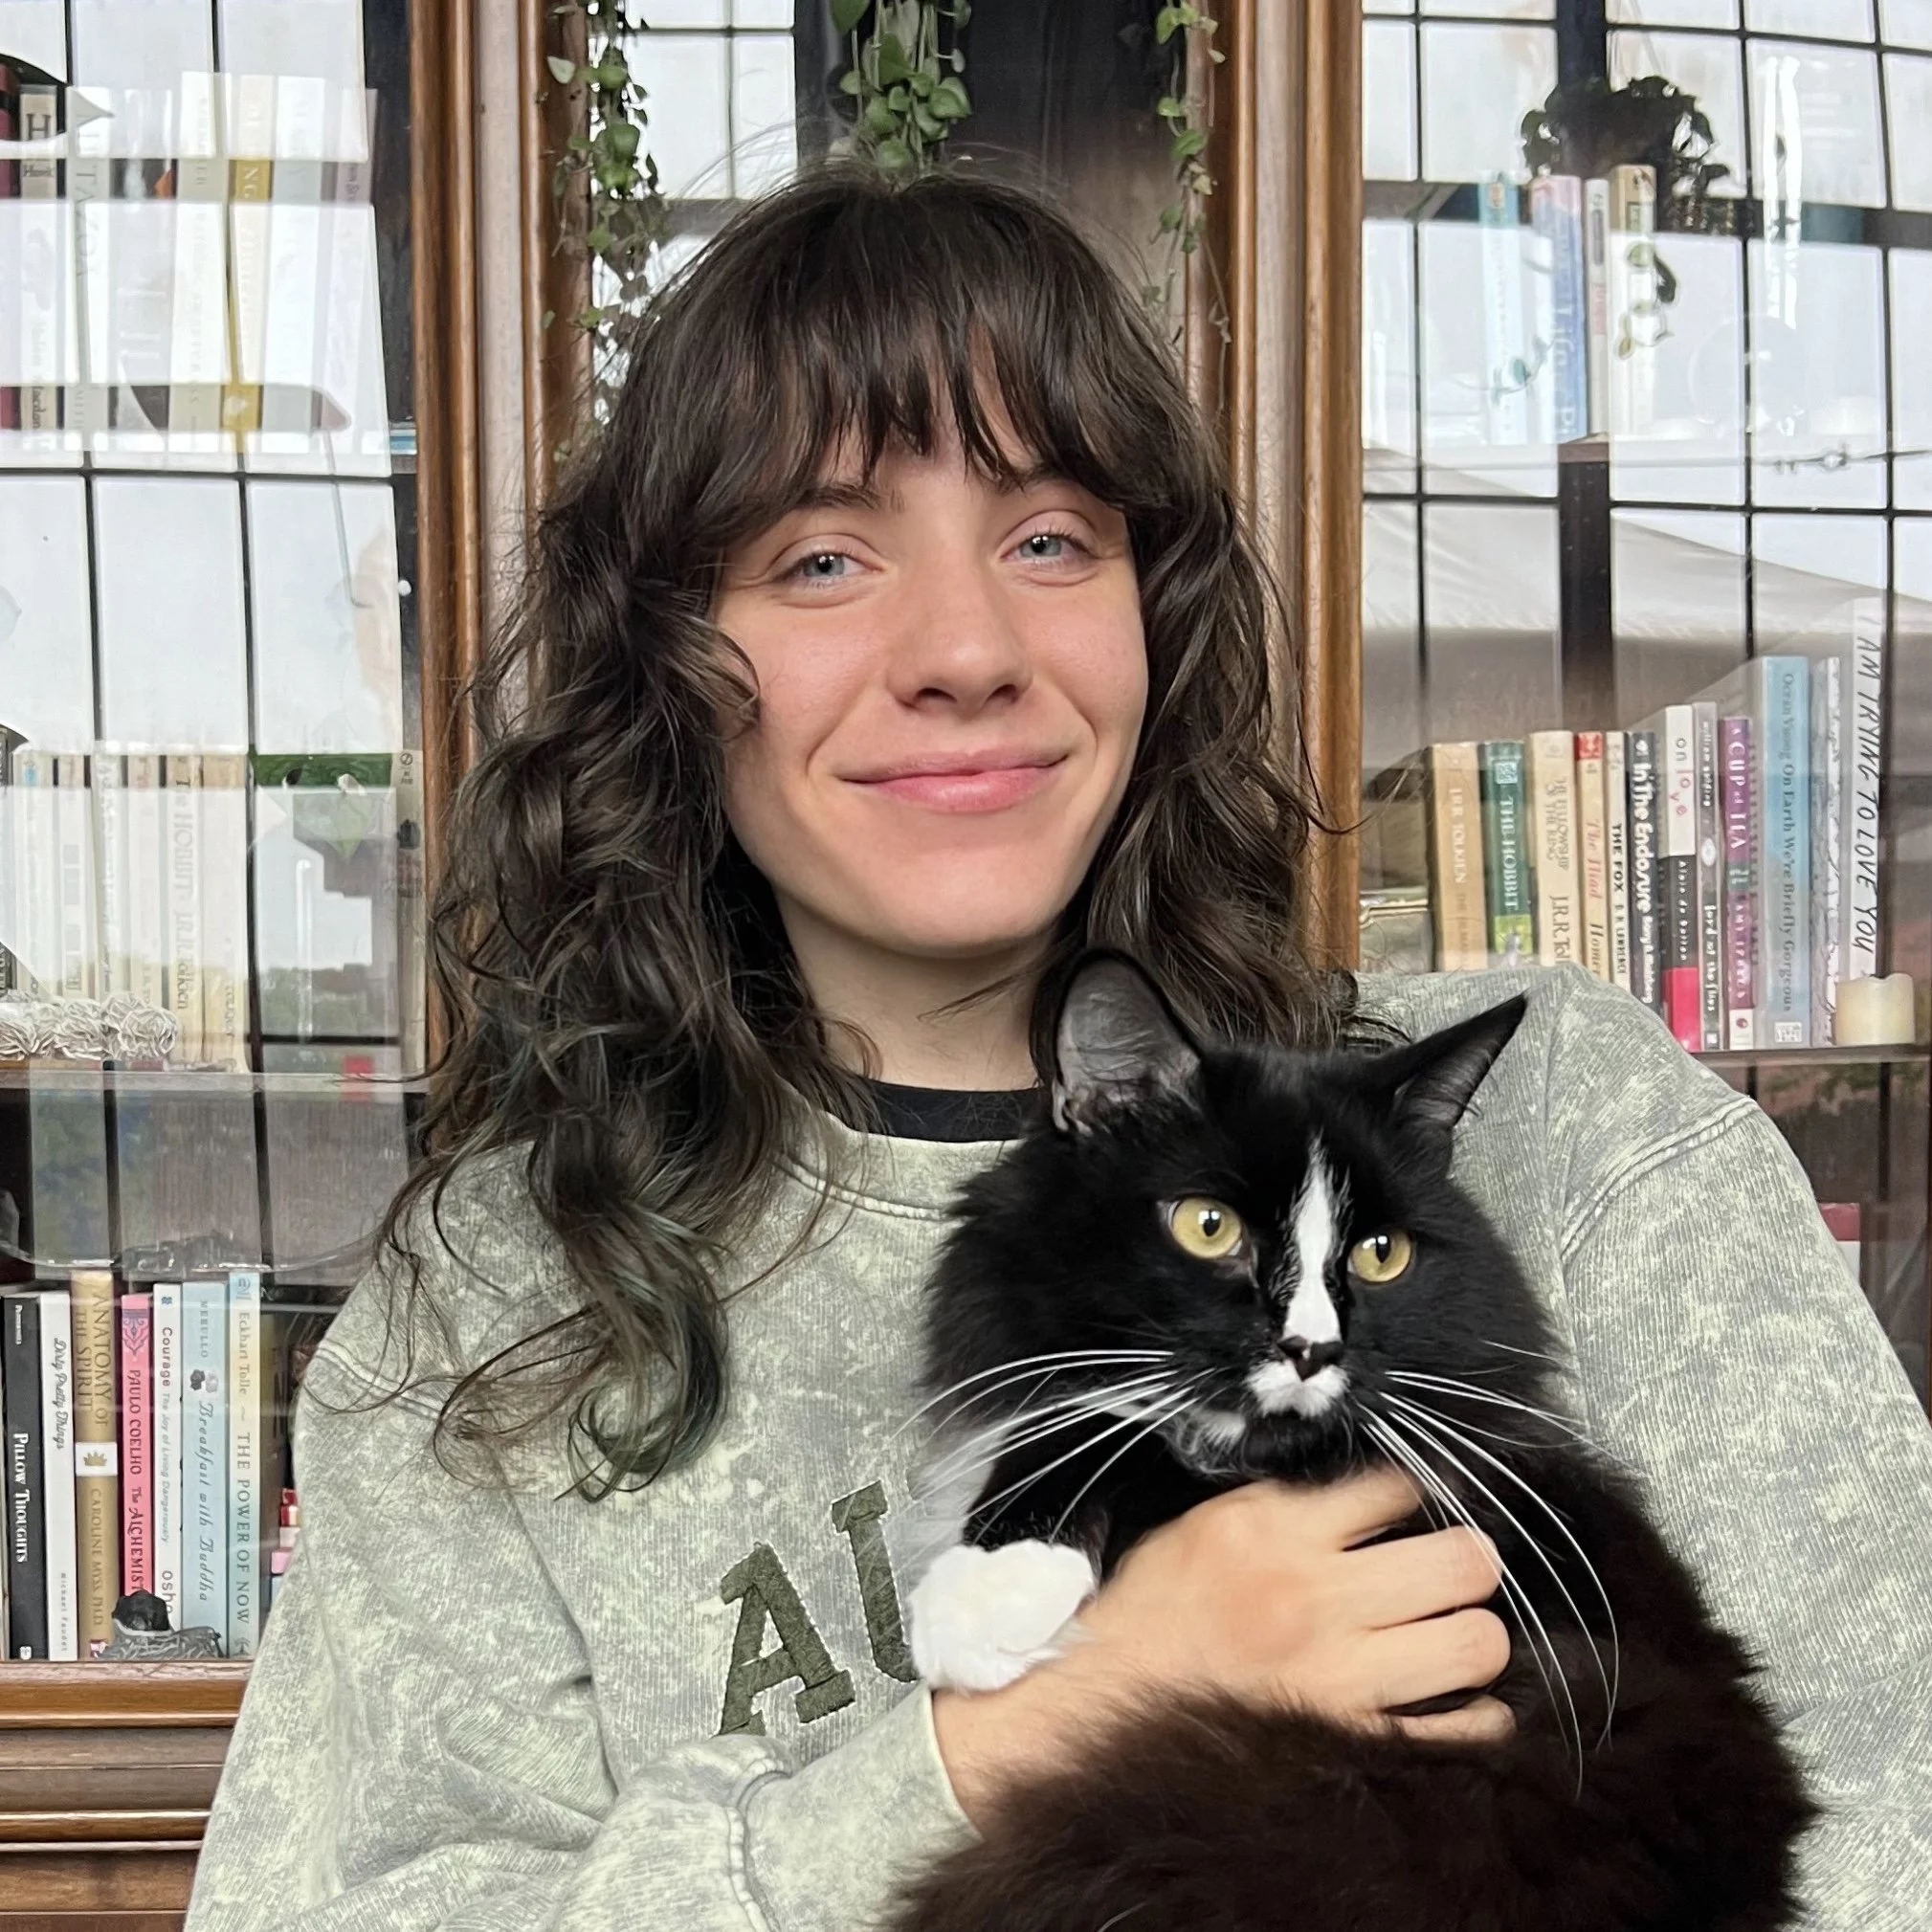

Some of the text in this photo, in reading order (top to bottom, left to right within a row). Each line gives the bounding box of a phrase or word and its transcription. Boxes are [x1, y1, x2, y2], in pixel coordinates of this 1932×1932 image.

[1856, 636, 1882, 679] AM
[1676, 738, 1688, 762] on
[1728, 741, 1746, 788] CUP
[1856, 691, 1882, 782] TRYING
[1632, 763, 1654, 782] In
[1633, 783, 1654, 821] The
[1783, 764, 1797, 786] On
[1783, 790, 1797, 832] Earth
[1855, 790, 1878, 820] TO
[1499, 795, 1520, 910] THE HOBBIT
[1588, 819, 1604, 900] The Iliad
[1612, 824, 1625, 892] THE FOX
[1783, 836, 1797, 878] We're
[1854, 830, 1878, 888] LOVE
[1779, 883, 1797, 935] Briefly
[1853, 906, 1878, 955] YOU
[1779, 941, 1797, 1012] Gorgeous
[76, 1345, 94, 1412] SPIRIT
[92, 1292, 113, 1402] ANATOMY
[159, 1326, 174, 1387] Courage
[238, 1311, 252, 1395] Eckhart Tolle
[51, 1338, 70, 1451] Dirty Pretty Things
[126, 1369, 143, 1475] PAULO COELHO
[161, 1392, 170, 1410] The
[161, 1434, 171, 1445] of
[13, 1432, 32, 1564] PILLOW THOUGHTS
[90, 1489, 104, 1555] CAROLINE
[160, 1480, 171, 1543] Dangerously
[194, 1400, 215, 1601] Breakfast with Buddha
[235, 1432, 251, 1624] THE POWER OF NOW
[127, 1487, 144, 1591] The ALCHEMIST
